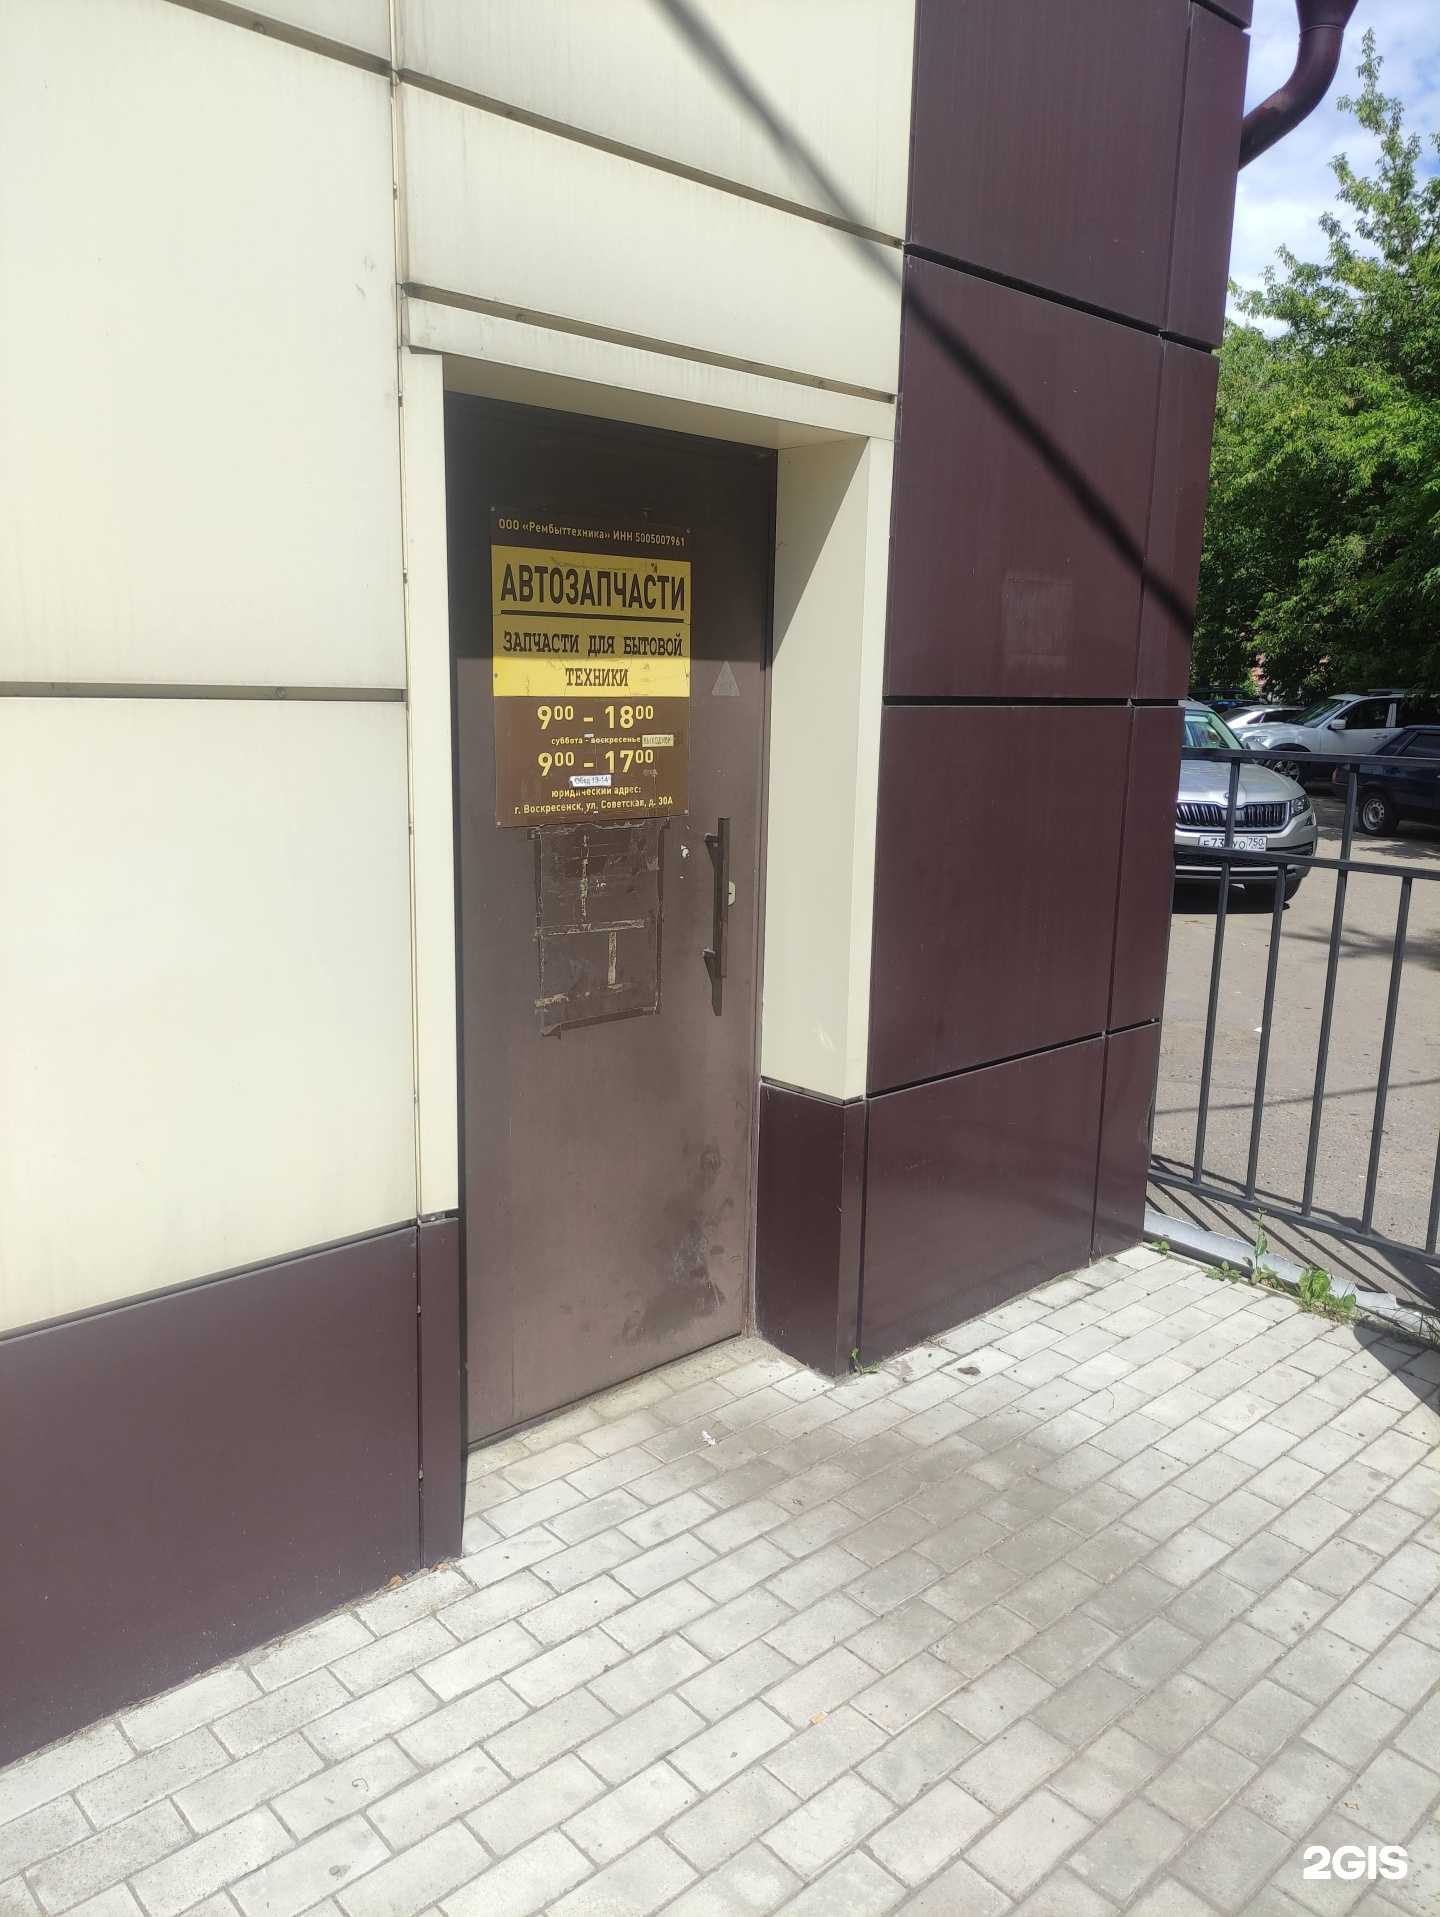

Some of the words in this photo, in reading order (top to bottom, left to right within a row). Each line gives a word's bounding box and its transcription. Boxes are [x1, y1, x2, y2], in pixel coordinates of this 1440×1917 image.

[499, 518, 519, 530] ООО
[522, 521, 610, 539] «Рембыттехника»
[613, 530, 633, 542] ИНН
[635, 532, 685, 547] 5005007961
[501, 563, 685, 611] АВТОЗАПЧАСТИ
[503, 631, 580, 653] ЗАПЧАСТИ
[588, 635, 615, 657] ДЛЯ
[623, 632, 683, 657] БЫТОВОЙ
[565, 668, 629, 687] ТЕХНИКИ
[551, 736, 583, 746] суббота
[590, 736, 641, 745] воскресенье
[614, 785, 641, 797] адрес:
[524, 803, 584, 814] Воскресенск,
[586, 802, 599, 813] ул.
[601, 799, 647, 810] Советская,
[658, 796, 673, 806] 30А
